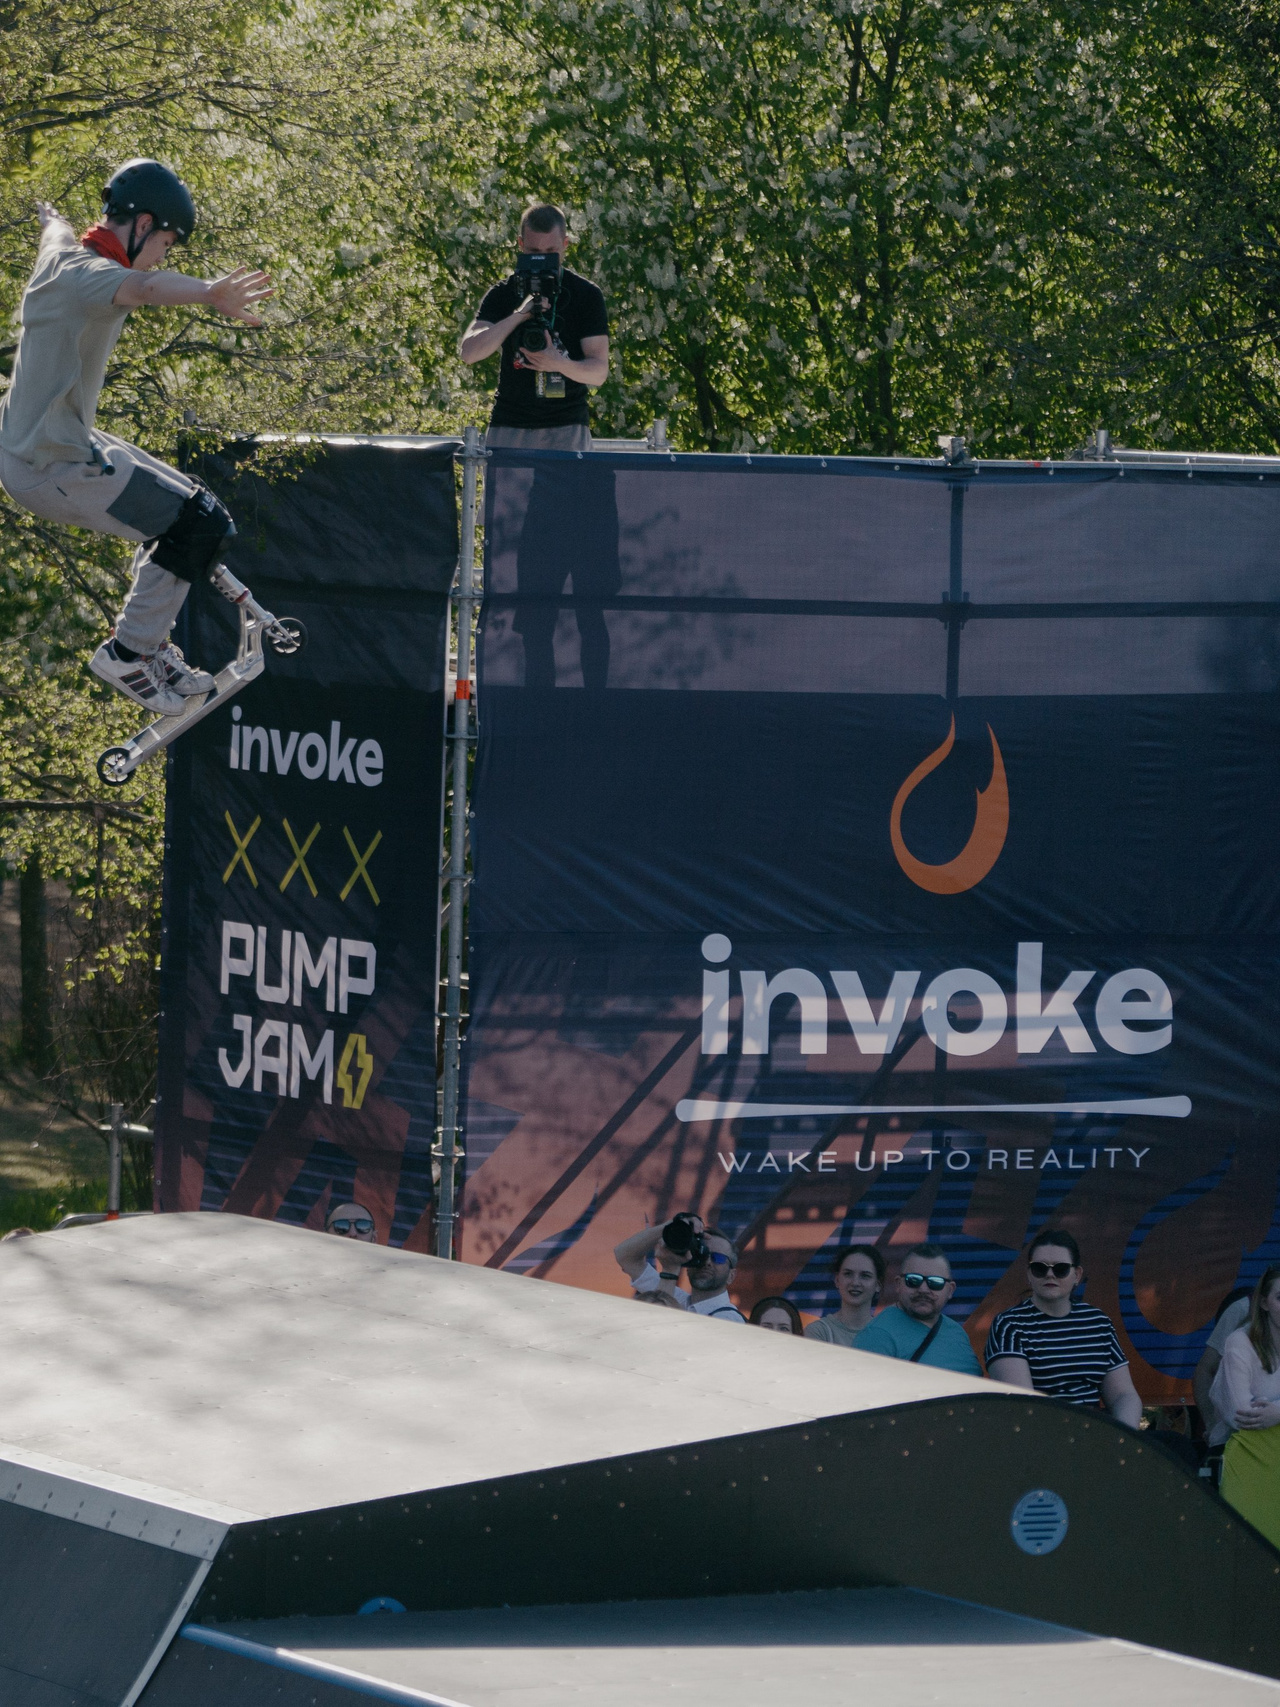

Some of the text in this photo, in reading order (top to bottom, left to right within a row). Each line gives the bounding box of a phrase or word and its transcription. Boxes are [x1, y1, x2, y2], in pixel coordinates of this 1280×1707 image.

[229, 705, 384, 788] invoke
[220, 920, 377, 1015] PUMP
[700, 933, 1174, 1058] invoke
[218, 1013, 335, 1105] JAM
[717, 1147, 1151, 1174] WAKE UP TO REALITY
